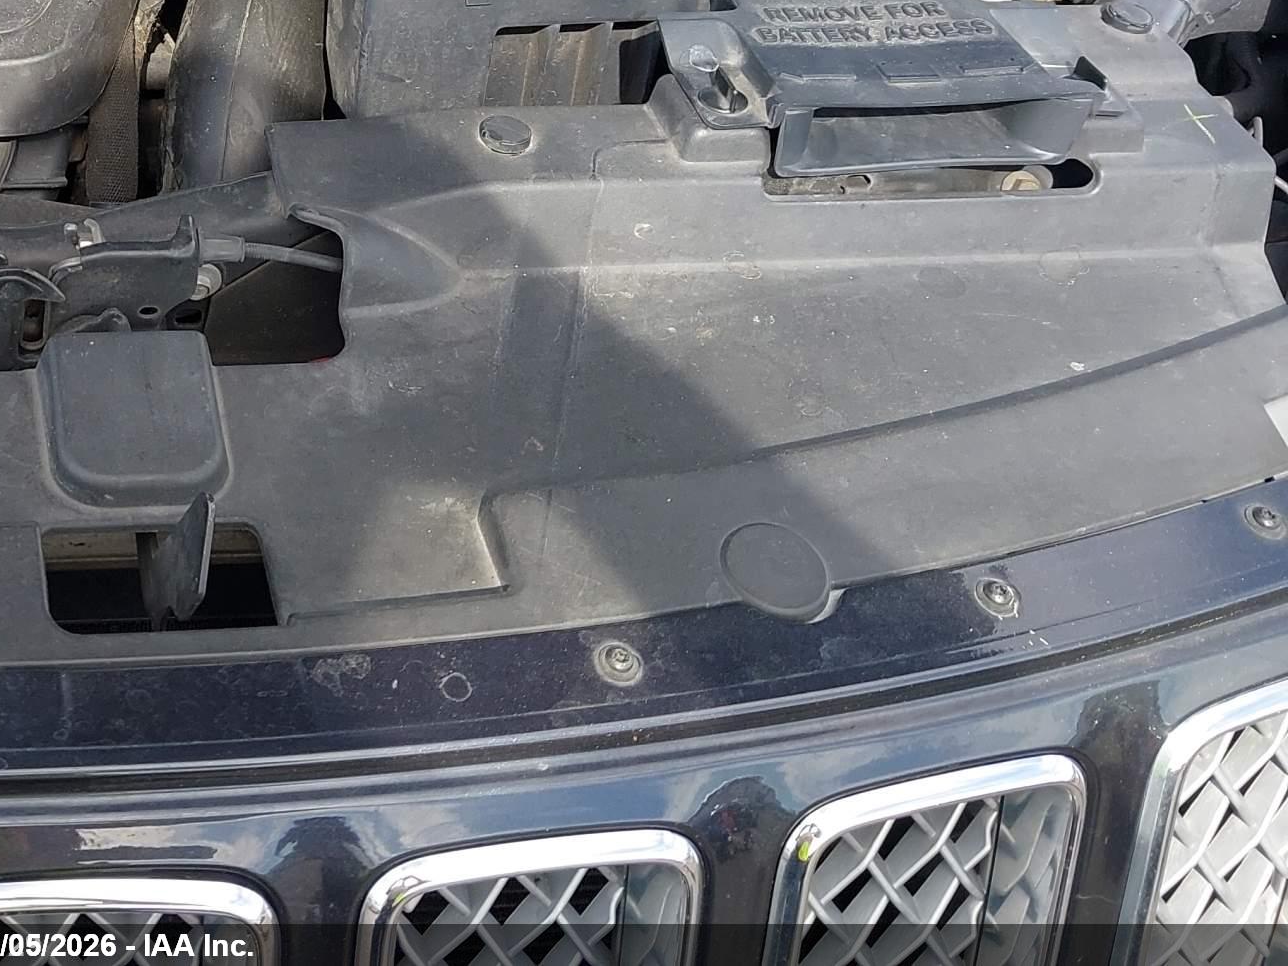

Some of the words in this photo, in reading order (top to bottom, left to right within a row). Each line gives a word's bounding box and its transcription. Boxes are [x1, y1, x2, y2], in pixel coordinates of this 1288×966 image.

[762, 5, 883, 23] REMOVE
[884, 1, 947, 19] FOR
[754, 25, 875, 44] BATTERY
[883, 18, 994, 42] ACCESS
